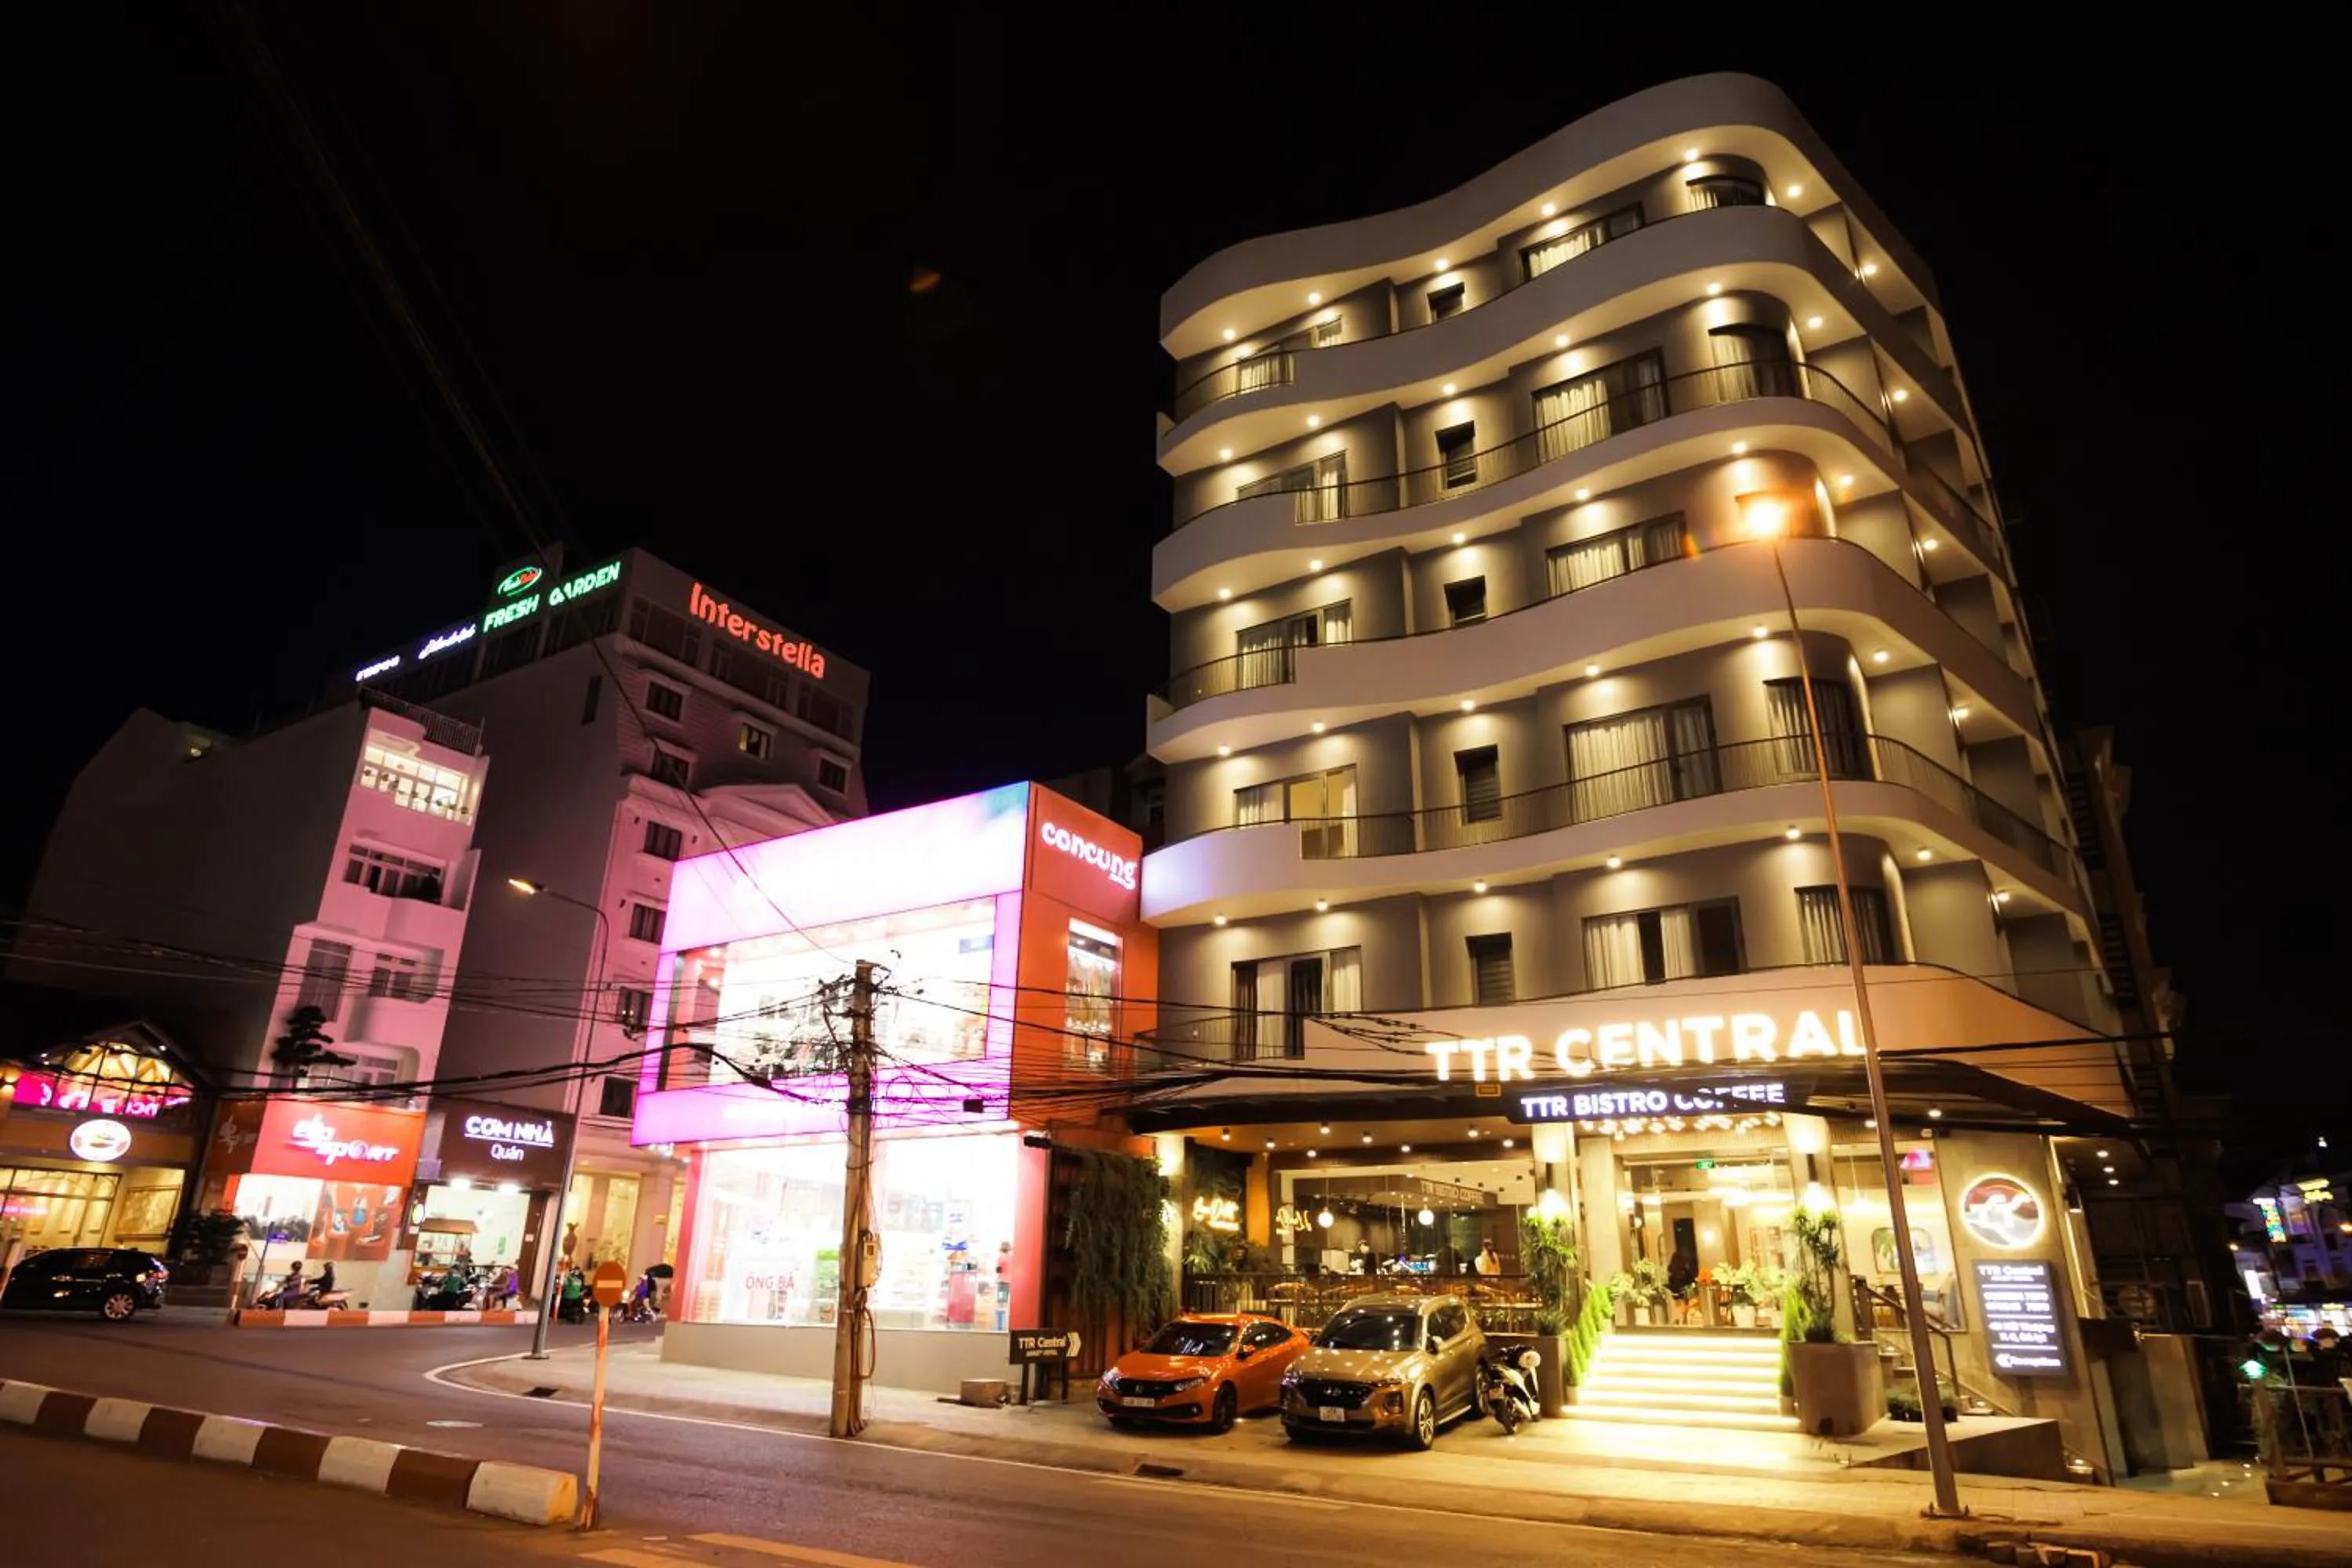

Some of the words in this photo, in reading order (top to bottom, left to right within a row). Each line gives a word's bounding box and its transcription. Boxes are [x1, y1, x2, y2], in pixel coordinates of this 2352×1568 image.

[483, 594, 540, 633] FRESH
[549, 561, 621, 606] GARDEN
[690, 582, 826, 679] Interstella
[1425, 1035, 1534, 1082] TTR
[1554, 1009, 1869, 1078] CENTRAL
[1521, 1096, 1568, 1118] TTR
[1574, 1090, 1668, 1115] BISTRO
